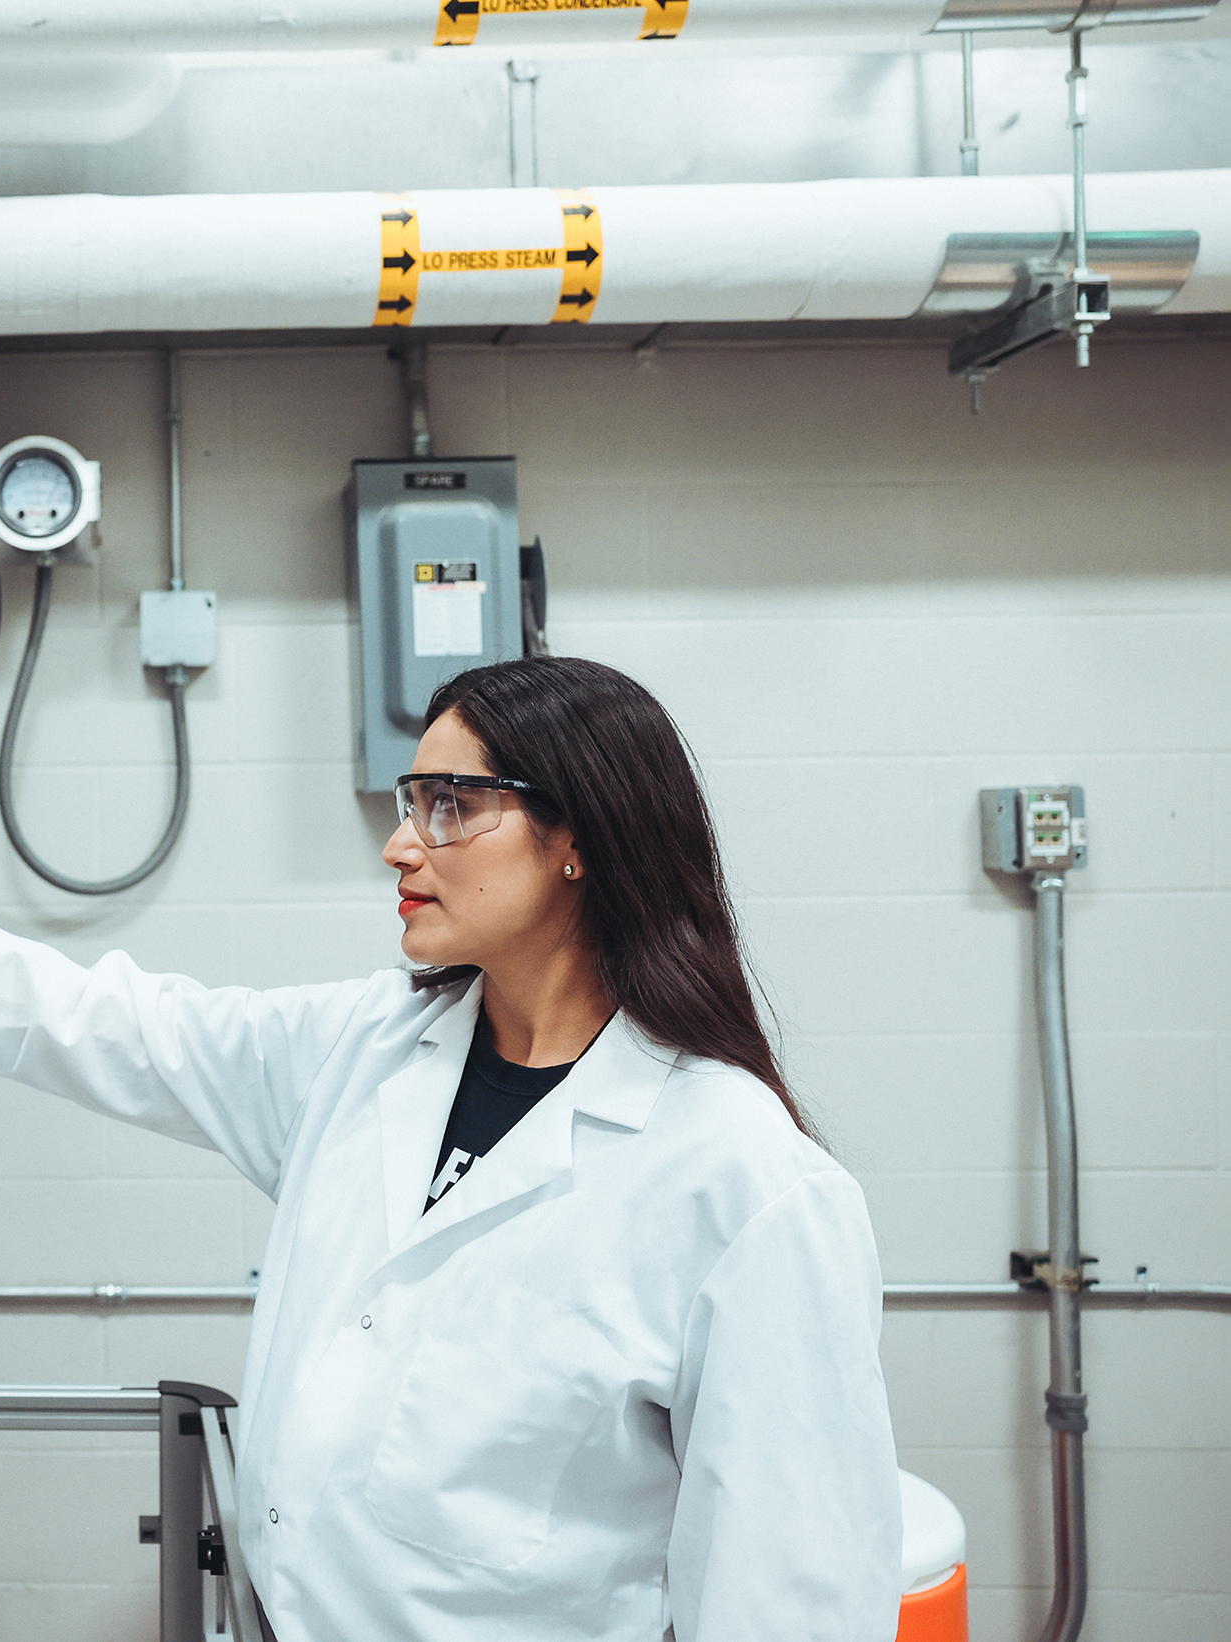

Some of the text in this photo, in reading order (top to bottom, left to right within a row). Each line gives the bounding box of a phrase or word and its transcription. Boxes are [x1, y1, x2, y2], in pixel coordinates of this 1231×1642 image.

[421, 249, 556, 270] LO PRESS STEAM
